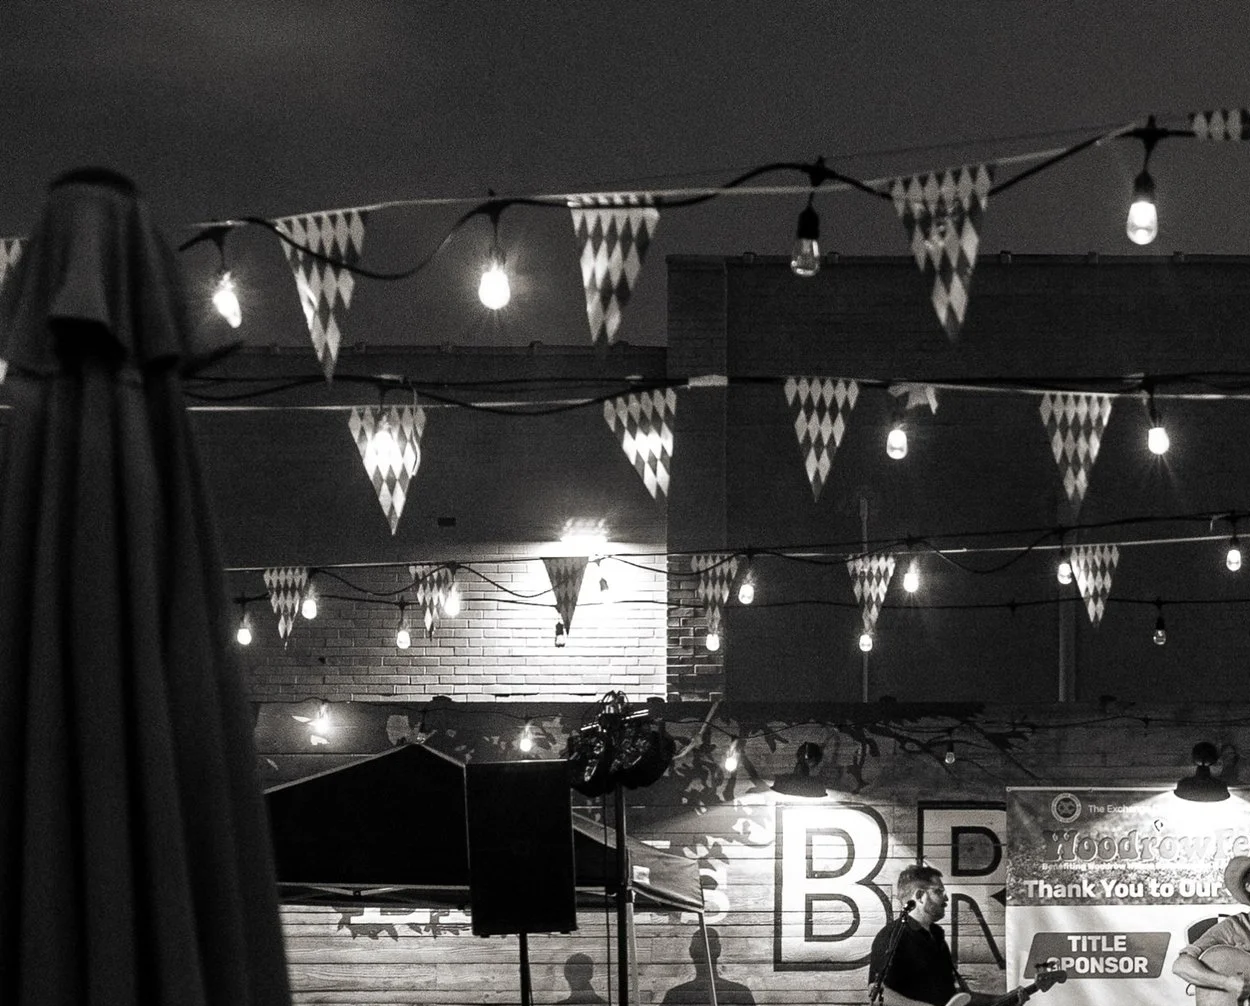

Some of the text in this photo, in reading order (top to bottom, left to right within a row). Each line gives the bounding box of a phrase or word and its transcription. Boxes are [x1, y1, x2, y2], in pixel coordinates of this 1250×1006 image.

[1088, 805, 1104, 813] The
[1024, 880, 1096, 898] Thank
[1101, 880, 1146, 898] You
[1150, 881, 1176, 898] to
[1180, 880, 1222, 898] Our
[1067, 935, 1127, 952] TITLE
[1046, 956, 1149, 974] SPONSOR
